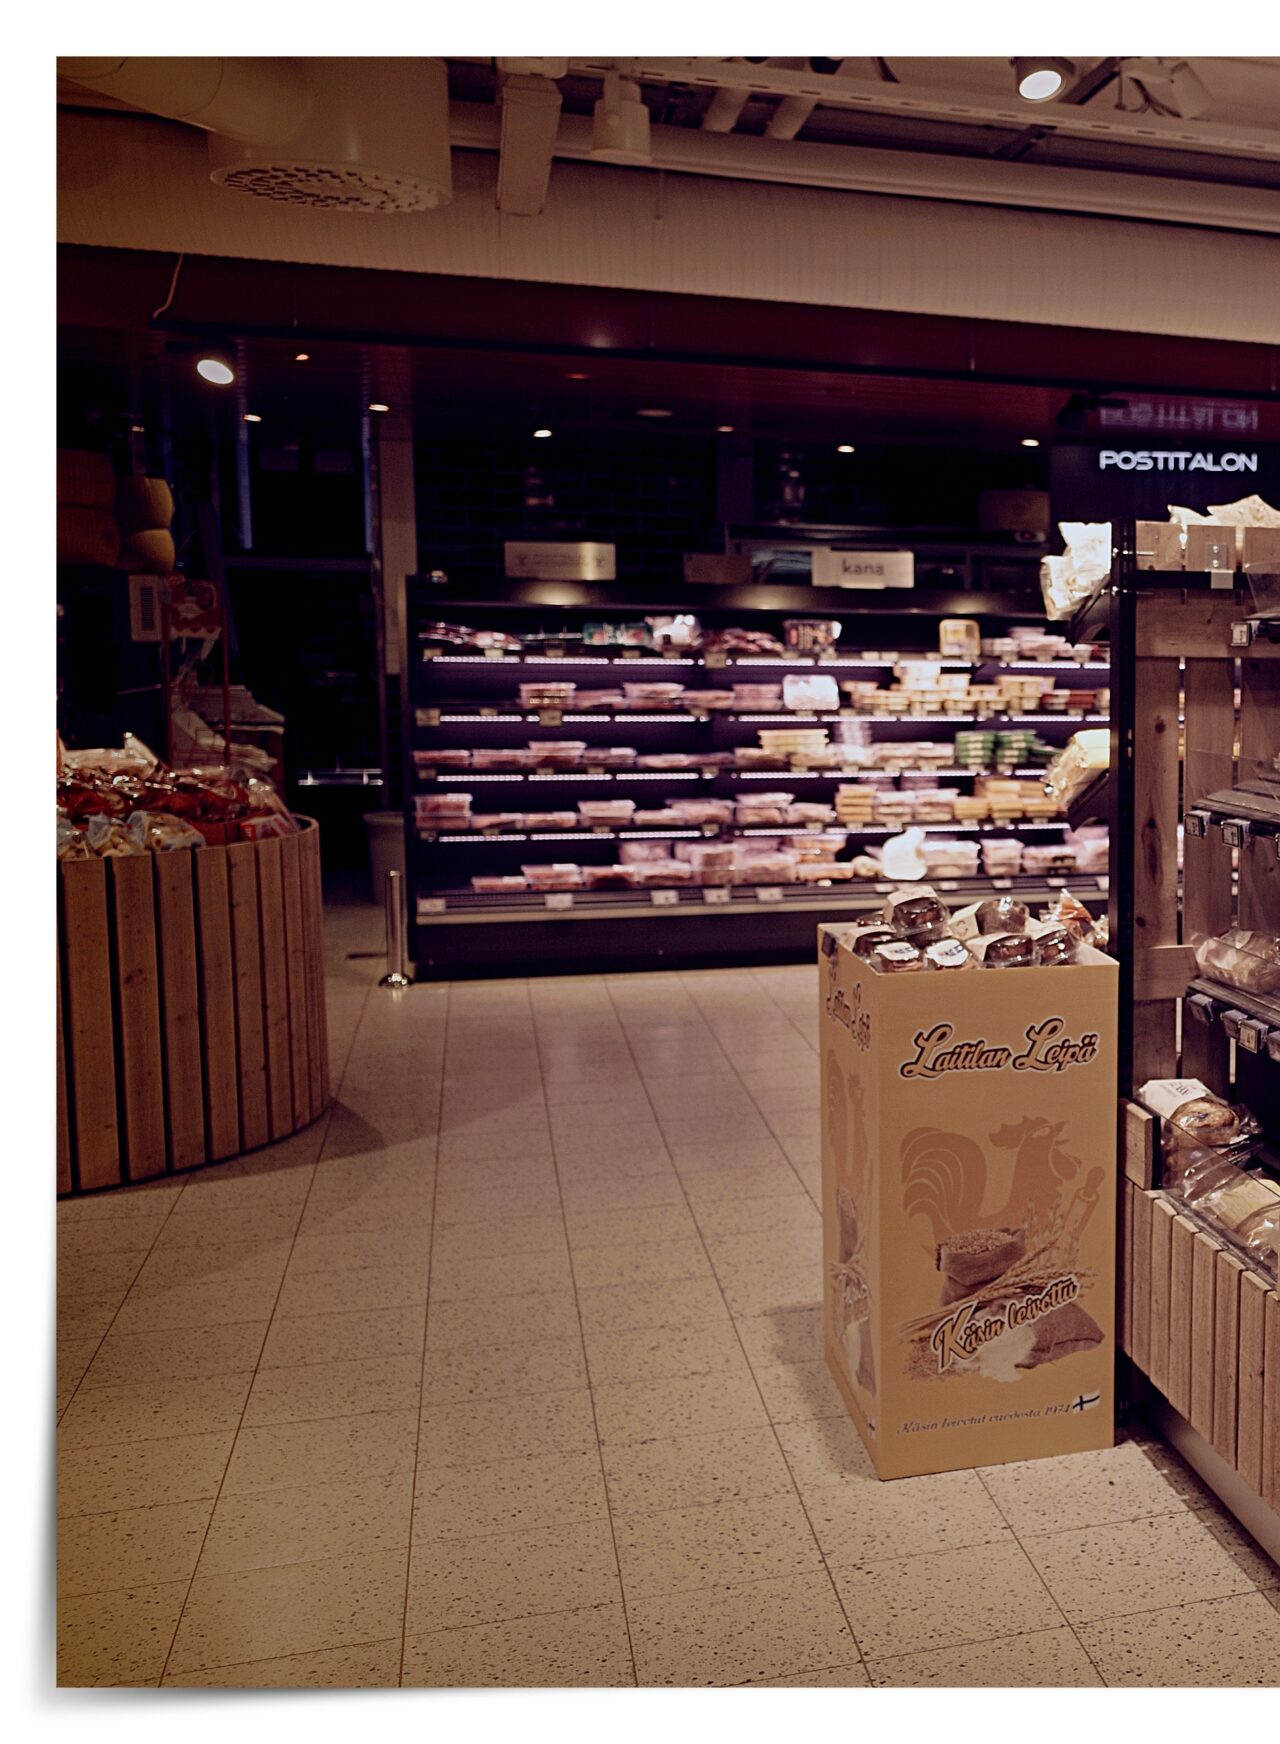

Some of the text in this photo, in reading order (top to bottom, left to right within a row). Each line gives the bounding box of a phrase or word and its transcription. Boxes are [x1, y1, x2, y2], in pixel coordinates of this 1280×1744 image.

[1098, 450, 1258, 473] POSTITALON
[841, 558, 885, 577] kana
[899, 1016, 1099, 1079] Laitilan Leipä
[931, 1277, 1079, 1370] Käsin leivottu
